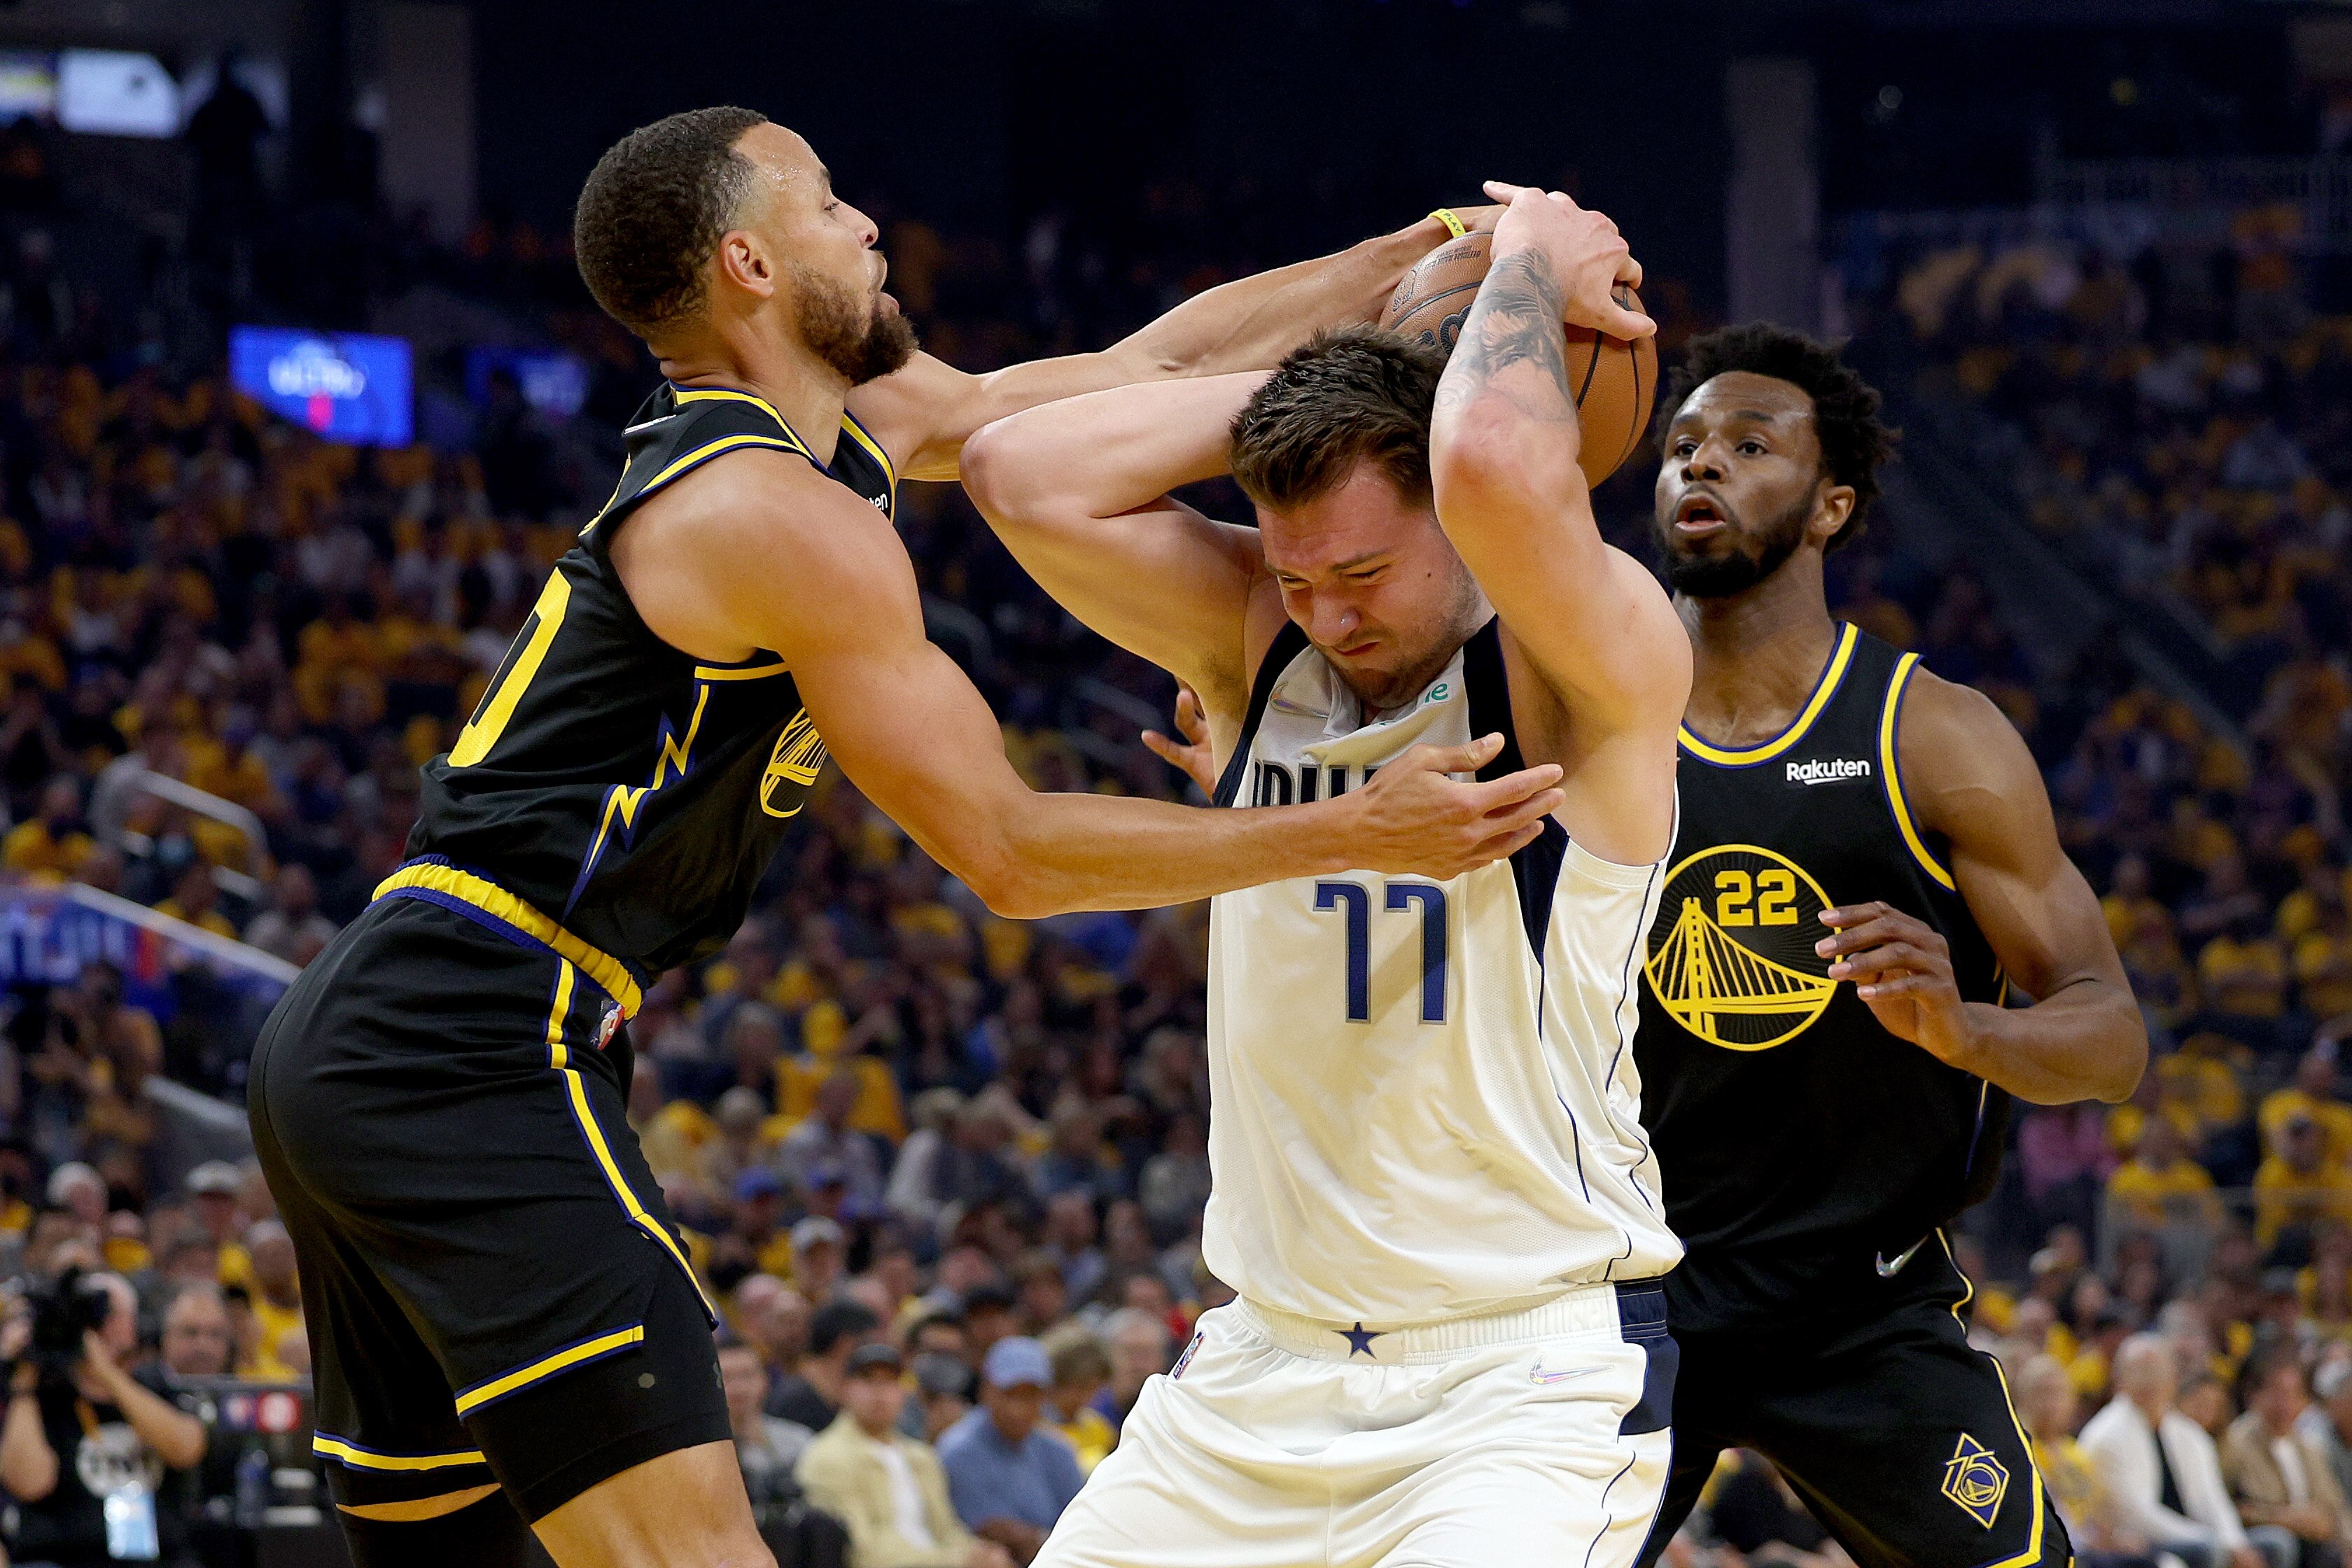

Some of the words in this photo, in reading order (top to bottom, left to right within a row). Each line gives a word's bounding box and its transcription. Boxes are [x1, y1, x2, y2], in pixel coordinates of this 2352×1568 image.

[1443, 212, 1461, 232] PLAY
[1786, 758, 1871, 782] Rakuten
[1714, 869, 1799, 926] 22
[1312, 880, 1450, 1025] 77
